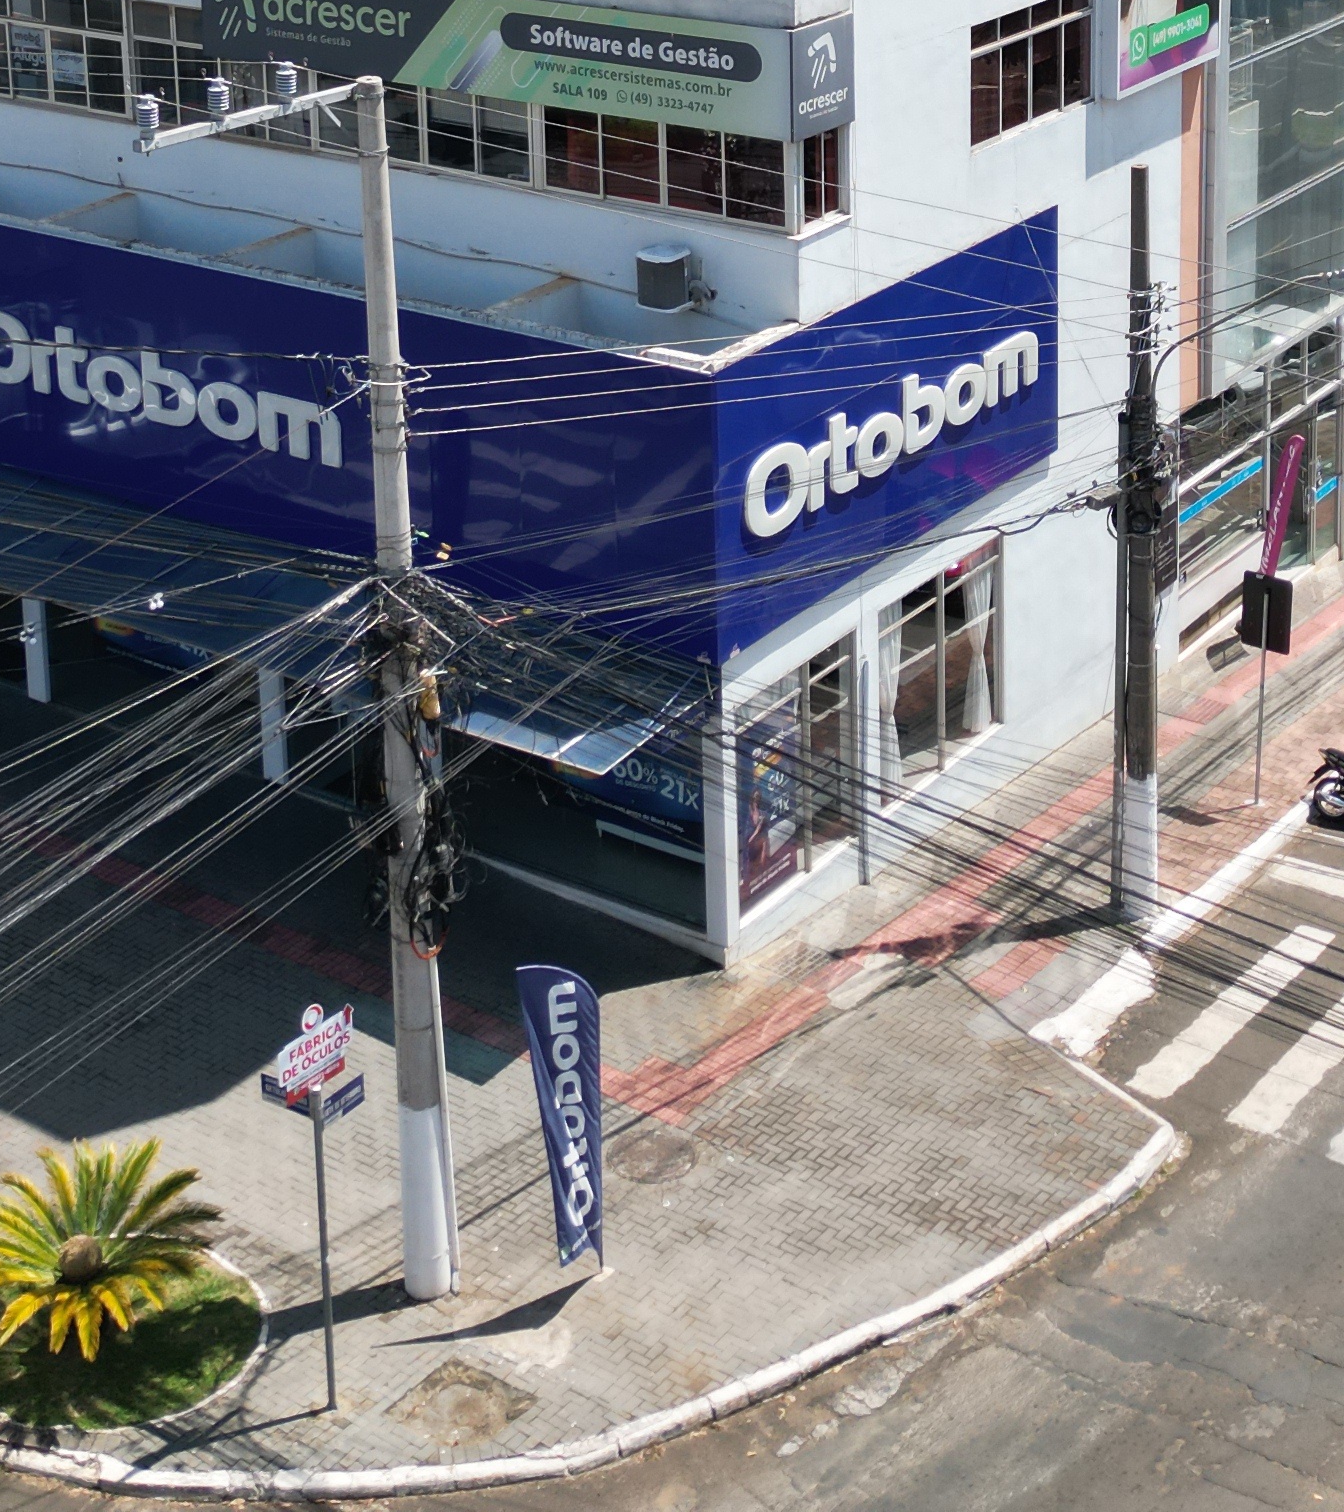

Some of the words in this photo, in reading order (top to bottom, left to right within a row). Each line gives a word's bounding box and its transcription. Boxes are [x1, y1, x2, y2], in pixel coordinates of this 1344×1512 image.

[266, 26, 305, 42] Sistemas
[307, 31, 318, 43] de
[320, 33, 352, 47] Gestão
[530, 24, 623, 55] Software
[627, 37, 654, 60] de
[658, 41, 735, 71] Gestão
[534, 59, 733, 98] www.acrescersistemas.com.br
[552, 82, 584, 98] SALA
[587, 87, 608, 101] 109
[630, 91, 653, 107] (49)
[657, 96, 715, 115] 3323-4747
[798, 87, 849, 115] acrescer
[744, 330, 1039, 539] Ortobom
[282, 1063, 300, 1084] DE
